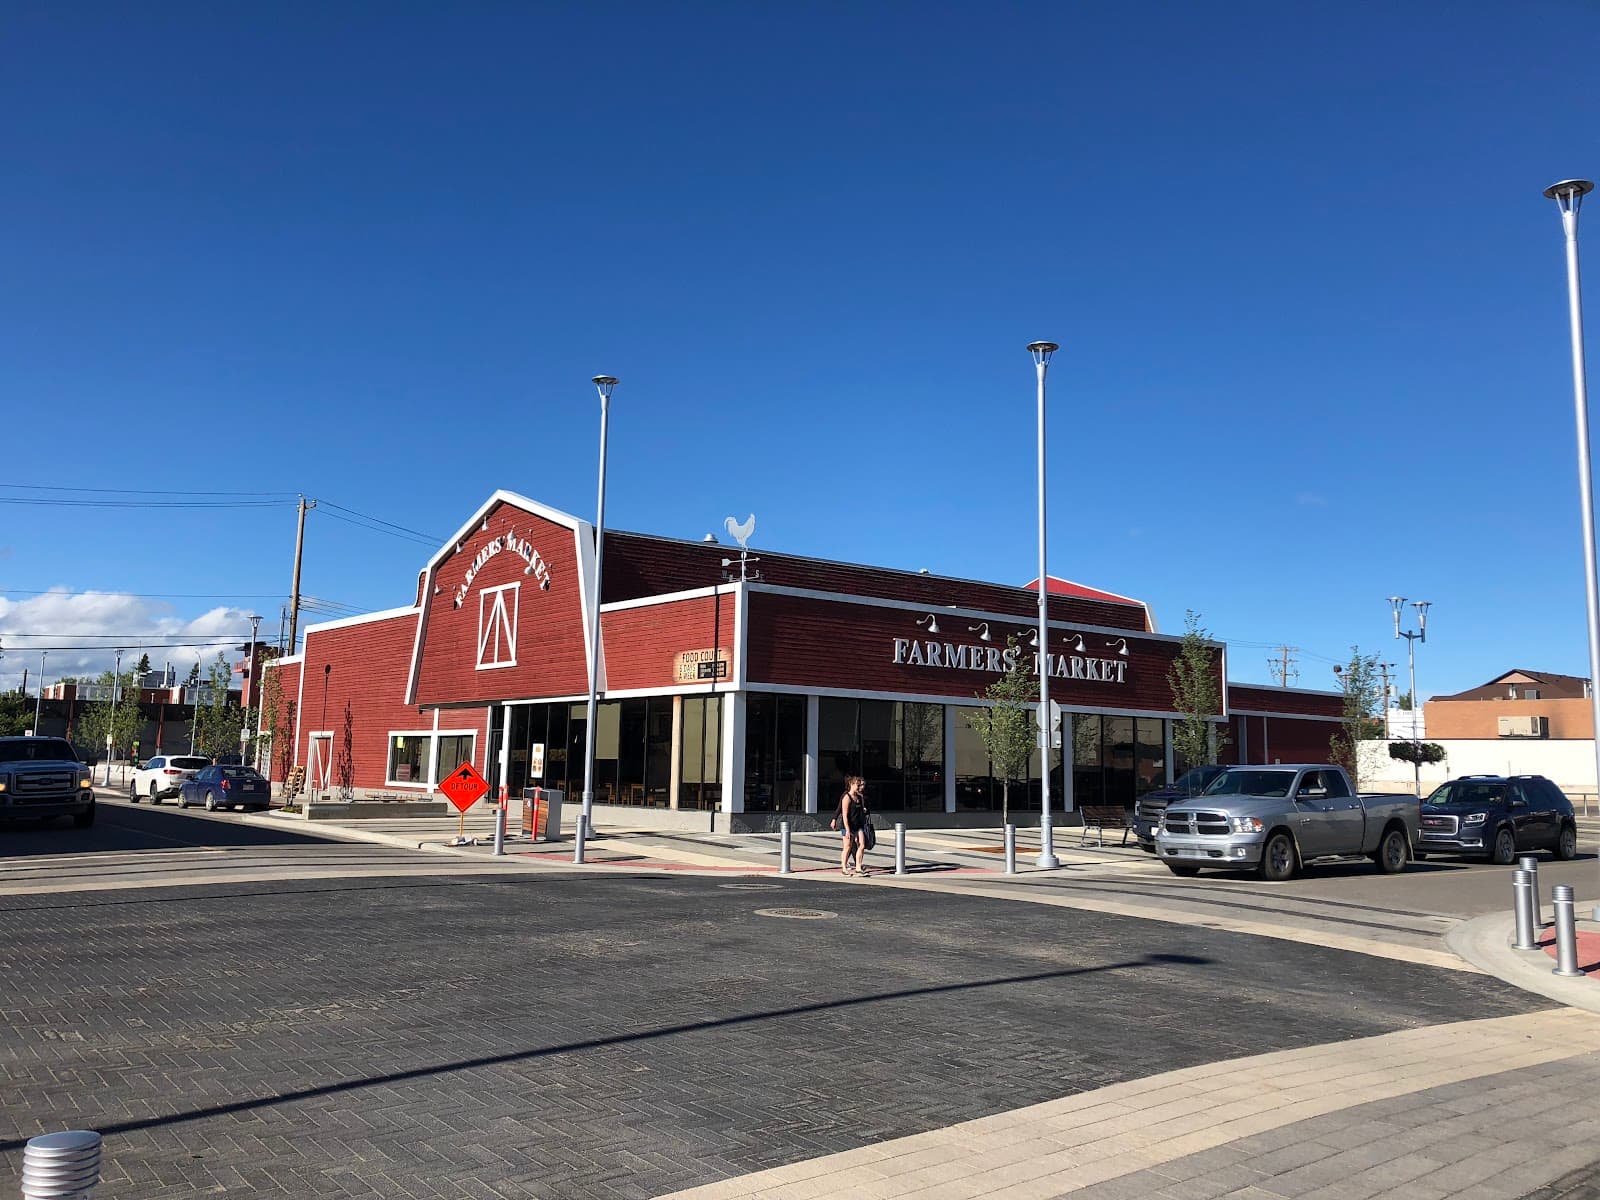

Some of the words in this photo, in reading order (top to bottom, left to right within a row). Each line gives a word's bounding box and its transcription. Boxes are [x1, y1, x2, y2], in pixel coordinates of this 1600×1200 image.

[506, 537, 551, 591] MARKET
[682, 652, 699, 663] FOOD
[701, 650, 722, 661] COUT
[892, 637, 1022, 673] FARMERS'
[1033, 651, 1128, 684] MARKET
[451, 782, 478, 791] DETOUR
